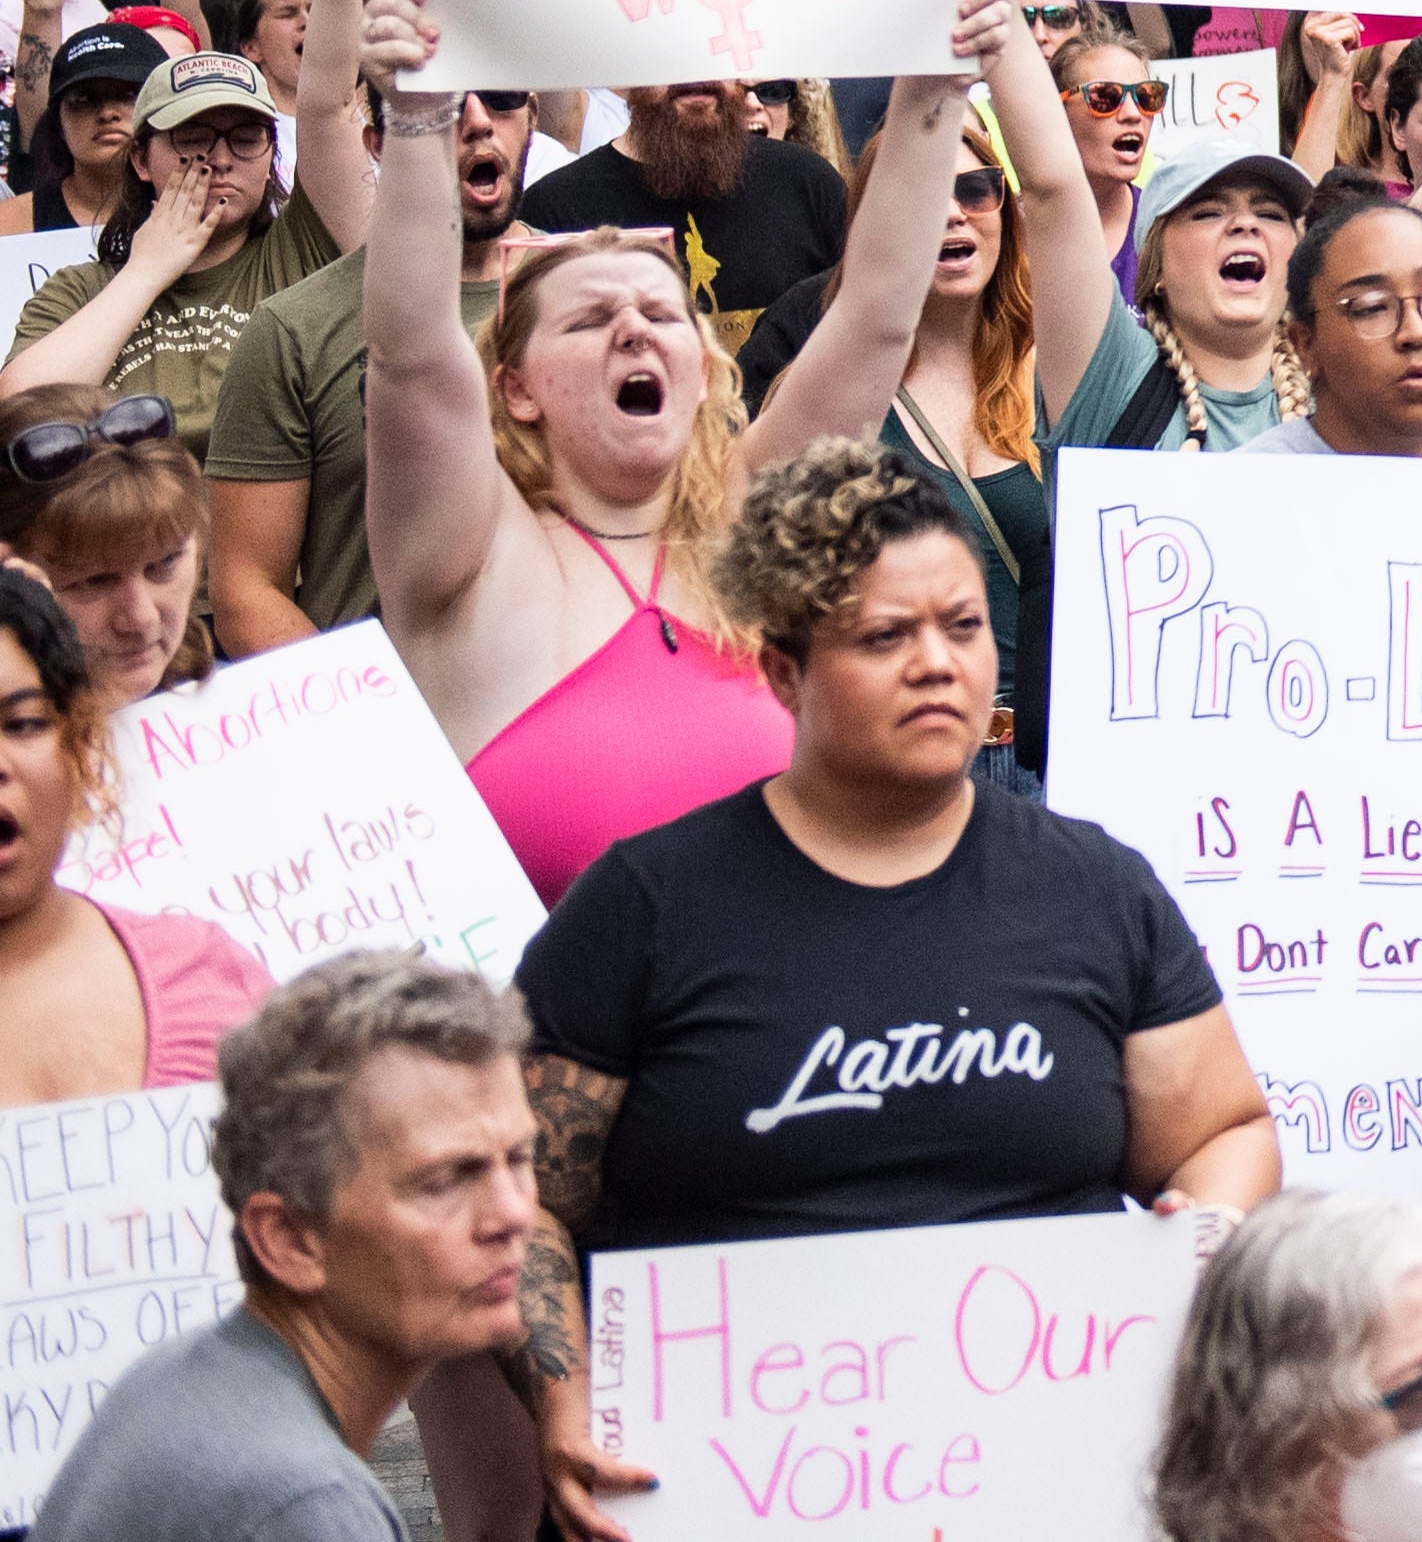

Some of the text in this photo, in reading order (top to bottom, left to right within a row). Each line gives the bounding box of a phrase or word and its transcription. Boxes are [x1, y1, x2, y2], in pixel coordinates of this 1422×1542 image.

[176, 57, 249, 76] ATLANTIC BEACH
[139, 664, 397, 780] Abortions
[1284, 789, 1325, 848] A
[208, 803, 436, 936] your laws
[278, 858, 436, 954] body!
[1237, 923, 1329, 975] Dont
[745, 1006, 1055, 1135] Latina
[22, 1204, 219, 1291] FILTHY
[6, 1304, 108, 1369] AWS
[593, 1285, 626, 1392] Latina
[648, 1257, 1157, 1422] Hear Our
